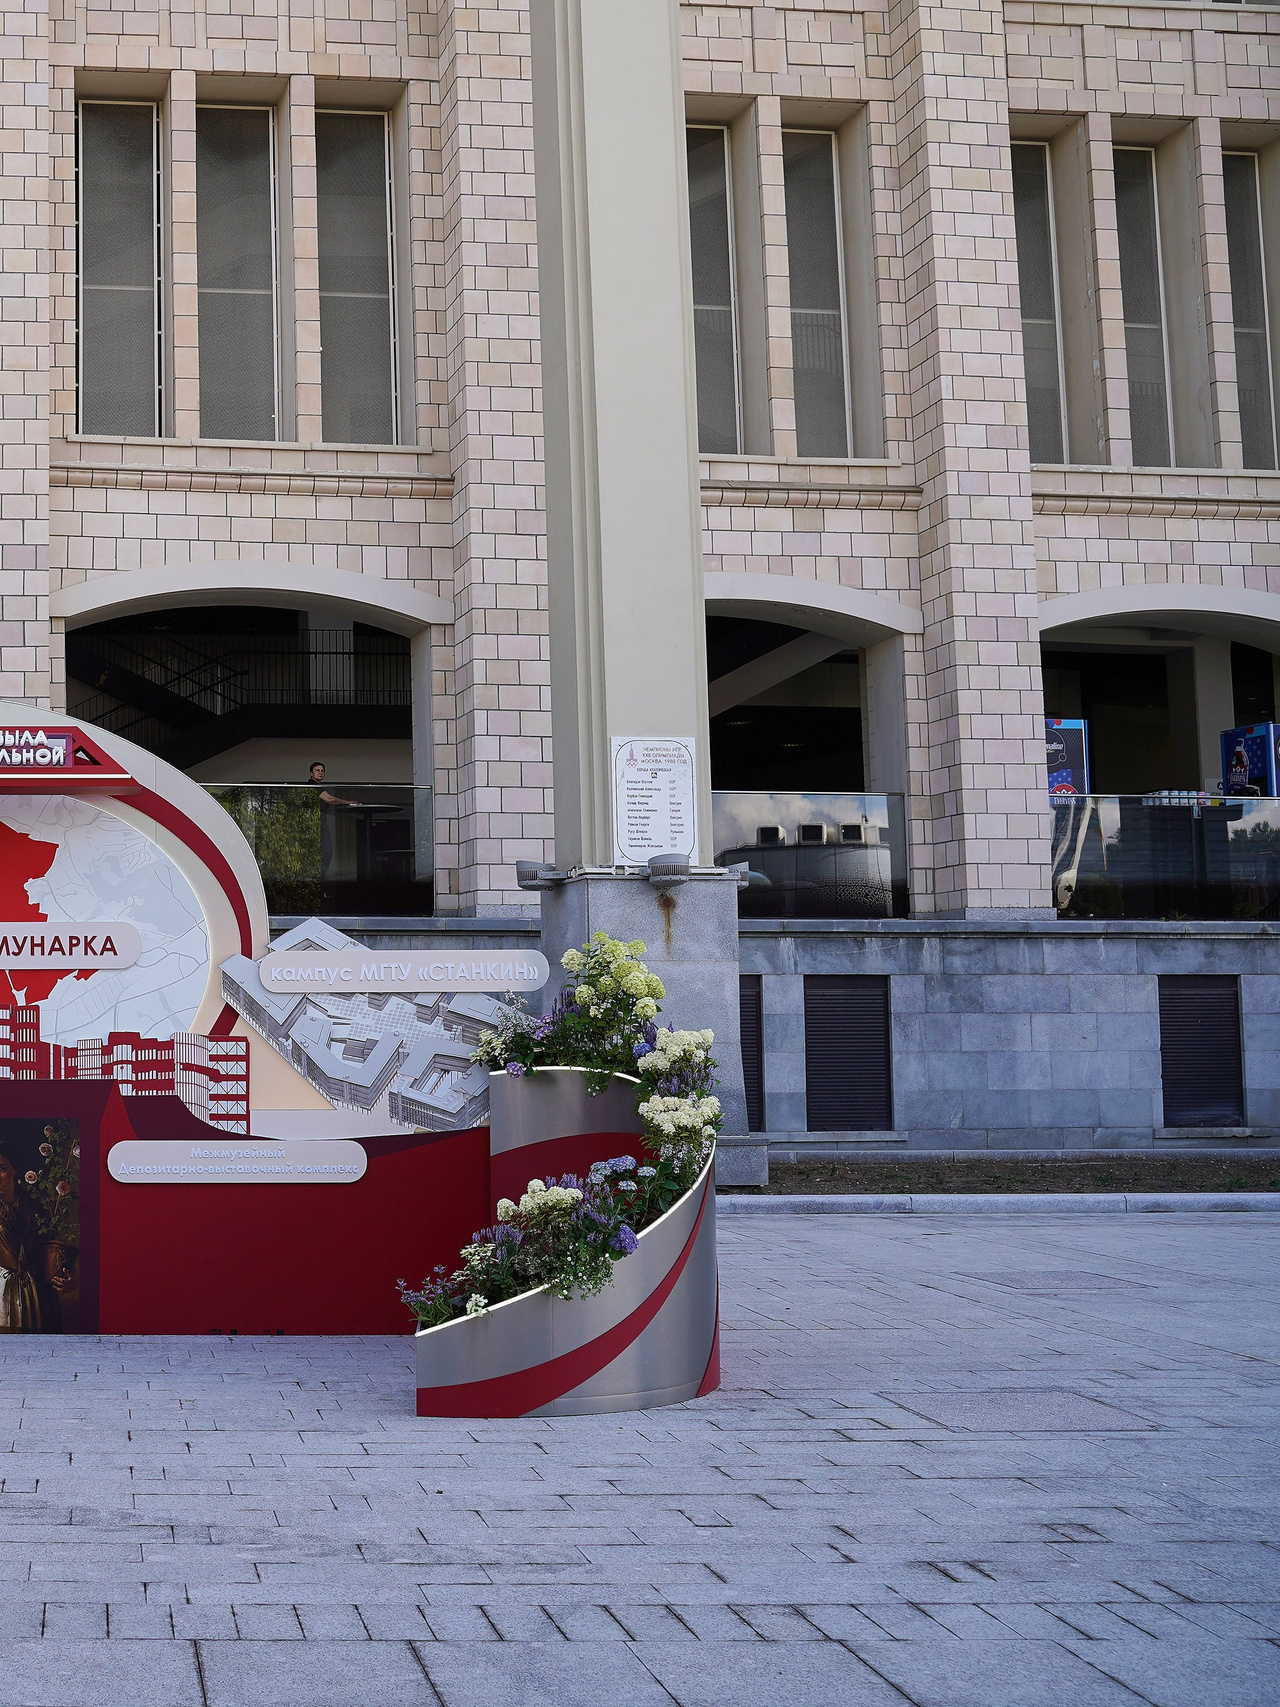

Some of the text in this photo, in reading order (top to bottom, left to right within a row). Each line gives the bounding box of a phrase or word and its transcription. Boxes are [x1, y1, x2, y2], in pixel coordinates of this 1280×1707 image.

[270, 962, 539, 985] кампус МГТУ «СТАНКИН»
[190, 1147, 286, 1161] Межмузейный
[117, 1162, 359, 1177] Депозитарно-выставочный комплекс
